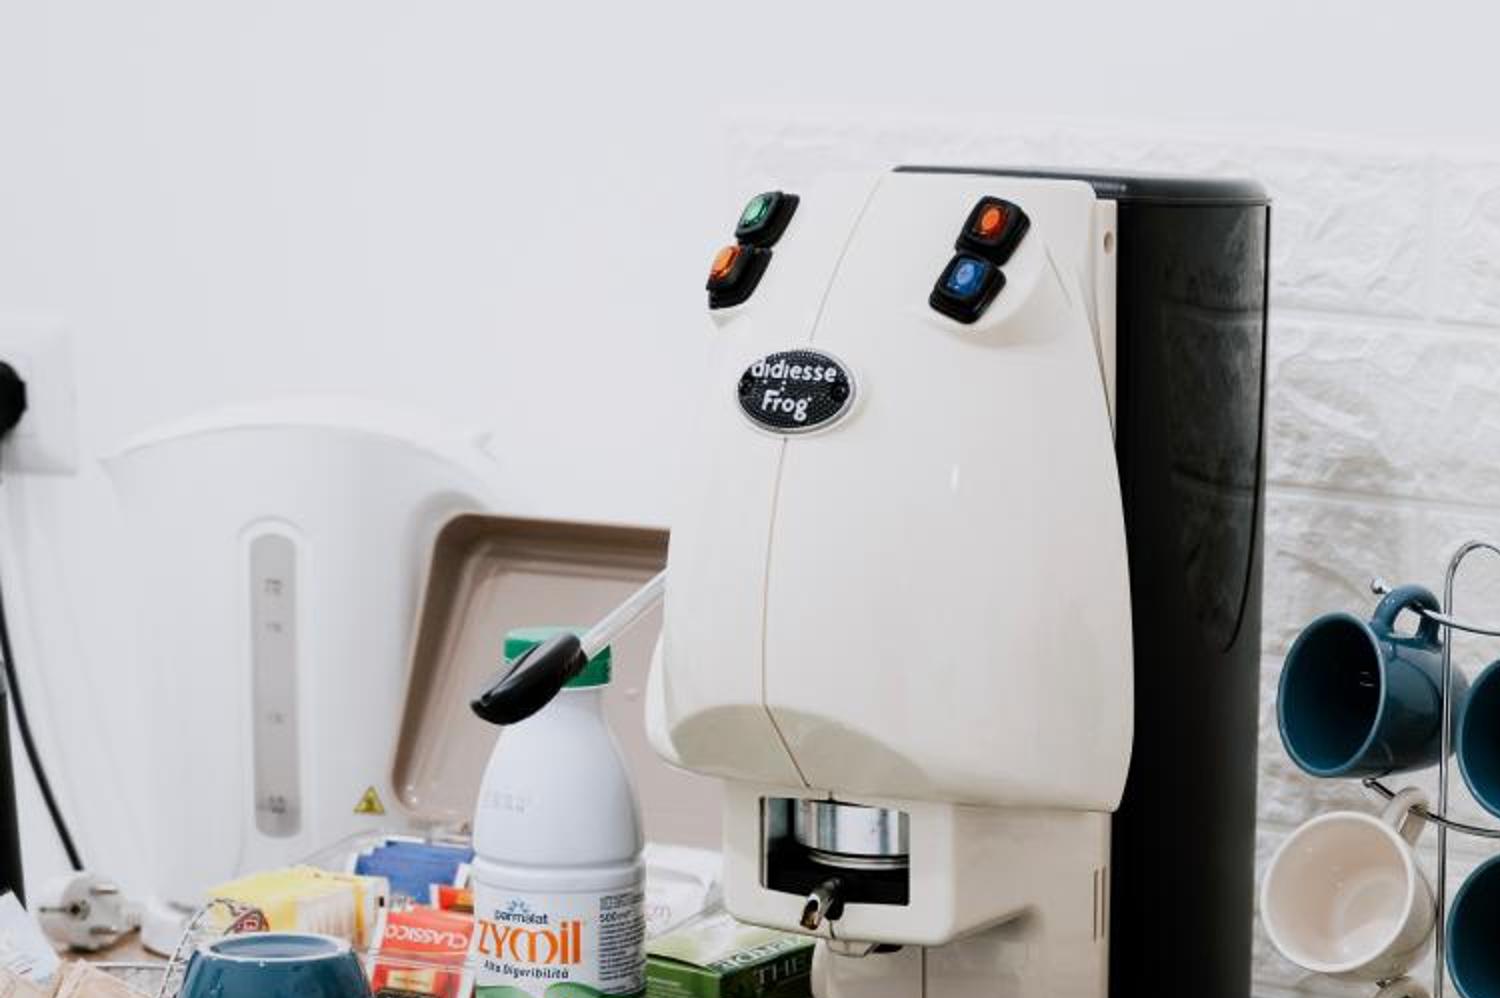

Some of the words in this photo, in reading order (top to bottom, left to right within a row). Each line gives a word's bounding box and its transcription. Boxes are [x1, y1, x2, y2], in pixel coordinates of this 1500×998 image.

[751, 359, 837, 384] didiesse
[761, 389, 808, 422] Frog
[385, 924, 469, 949] CLASSICO
